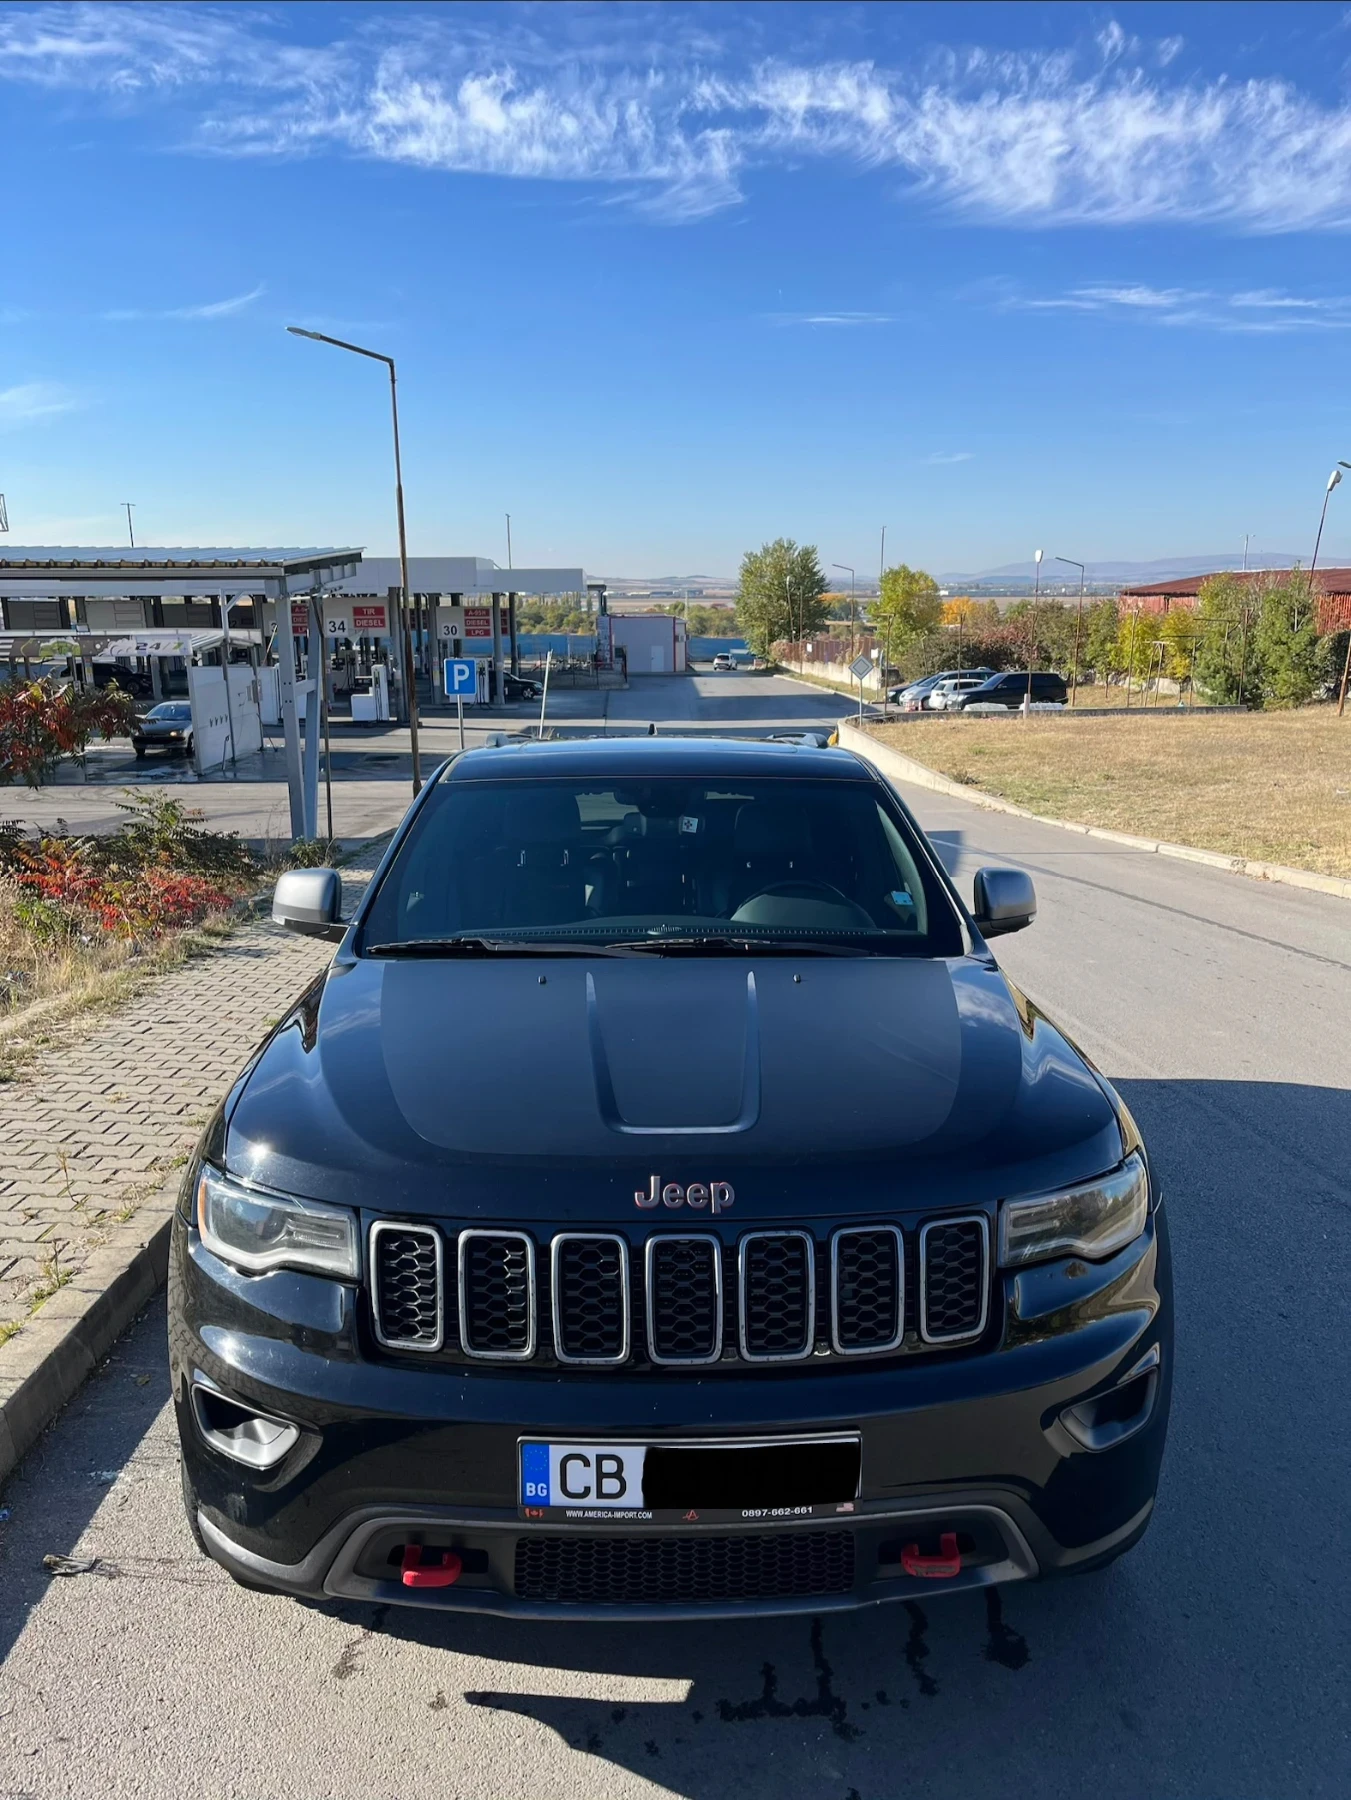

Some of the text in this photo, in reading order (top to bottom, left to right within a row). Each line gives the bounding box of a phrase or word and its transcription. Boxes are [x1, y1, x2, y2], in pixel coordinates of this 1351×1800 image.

[328, 620, 347, 633] 34
[355, 619, 384, 627] DIESEL
[443, 625, 458, 636] 30
[135, 642, 184, 651] 24/7
[453, 664, 470, 690] P
[634, 1175, 736, 1214] Jeep
[559, 1453, 627, 1500] CB
[526, 1482, 548, 1497] BG
[565, 1509, 653, 1519] WWW.AMERICA-IMPORT.COM
[741, 1506, 813, 1517] 0897-662-661
